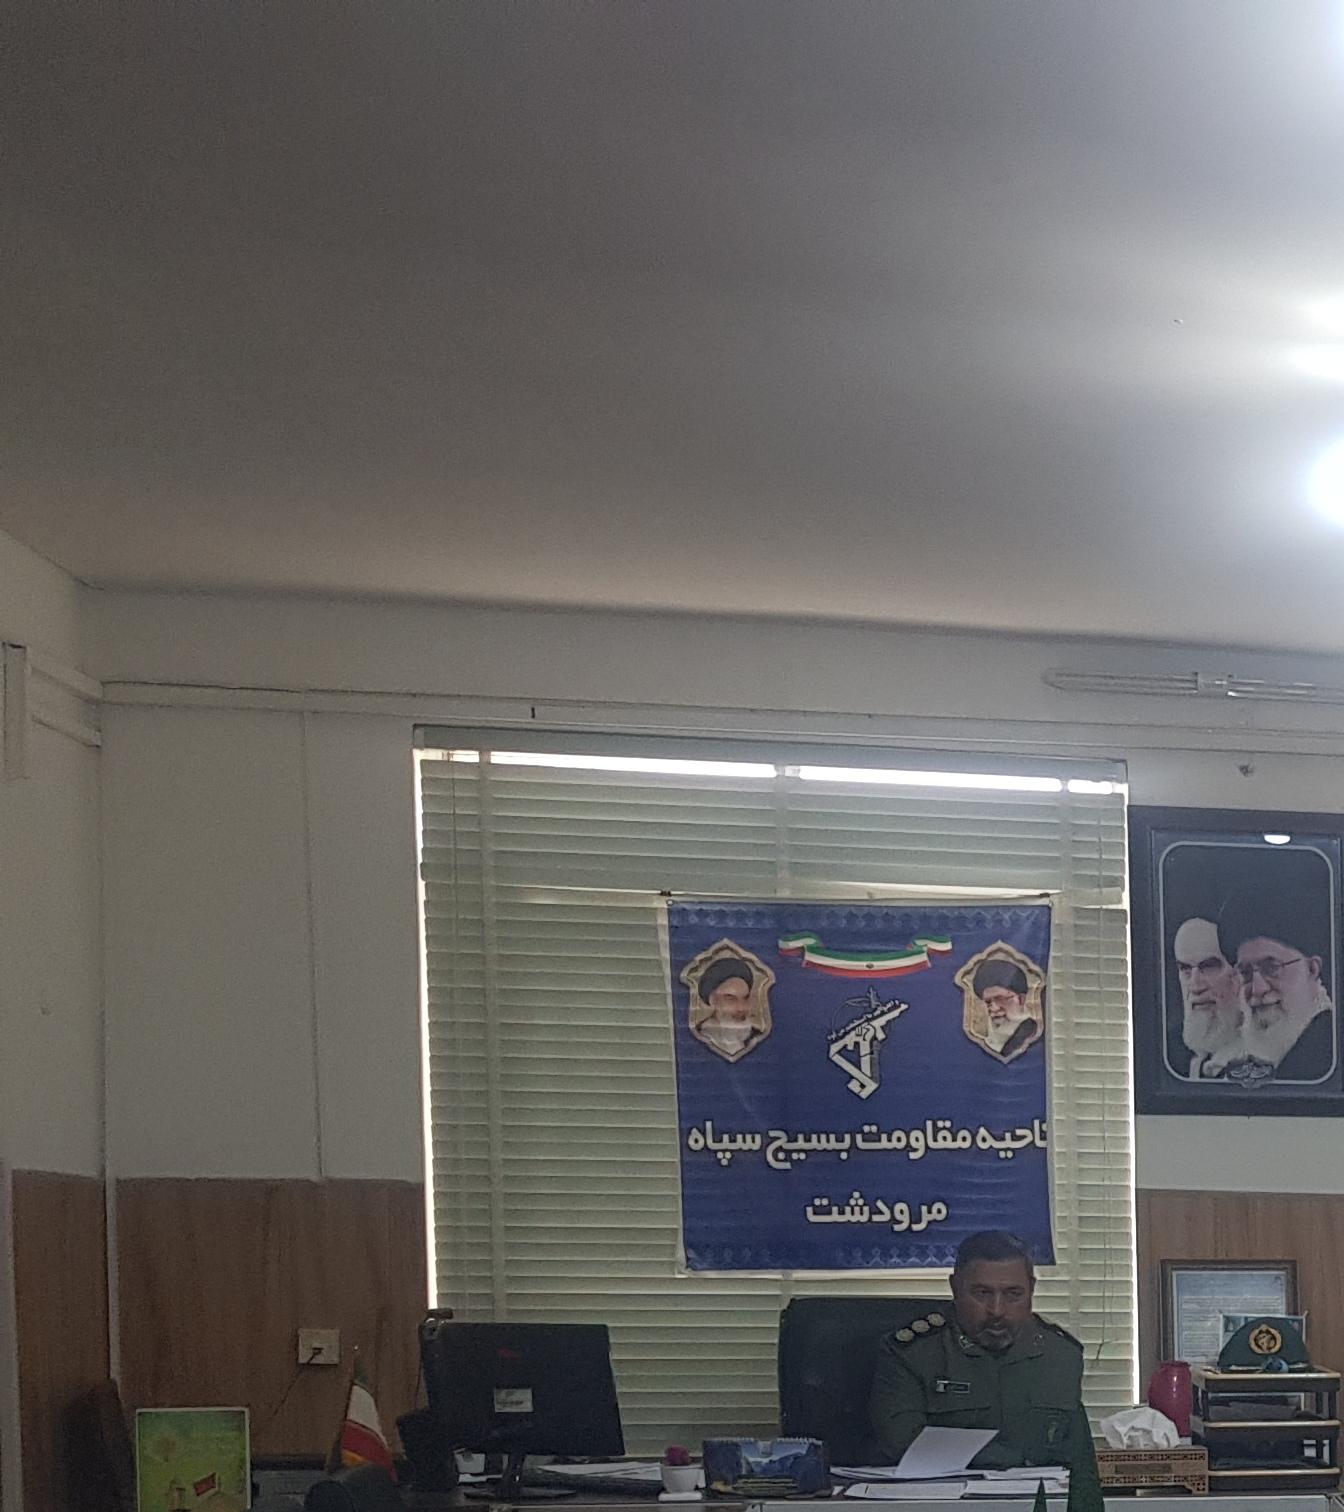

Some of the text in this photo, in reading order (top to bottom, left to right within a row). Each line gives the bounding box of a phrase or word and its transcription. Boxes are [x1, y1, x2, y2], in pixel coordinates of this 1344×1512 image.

[687, 1121, 763, 1167] سپاه
[766, 1124, 852, 1169] بسیج
[855, 1120, 972, 1160] مقاومت
[805, 1191, 949, 1231] مرودشت
